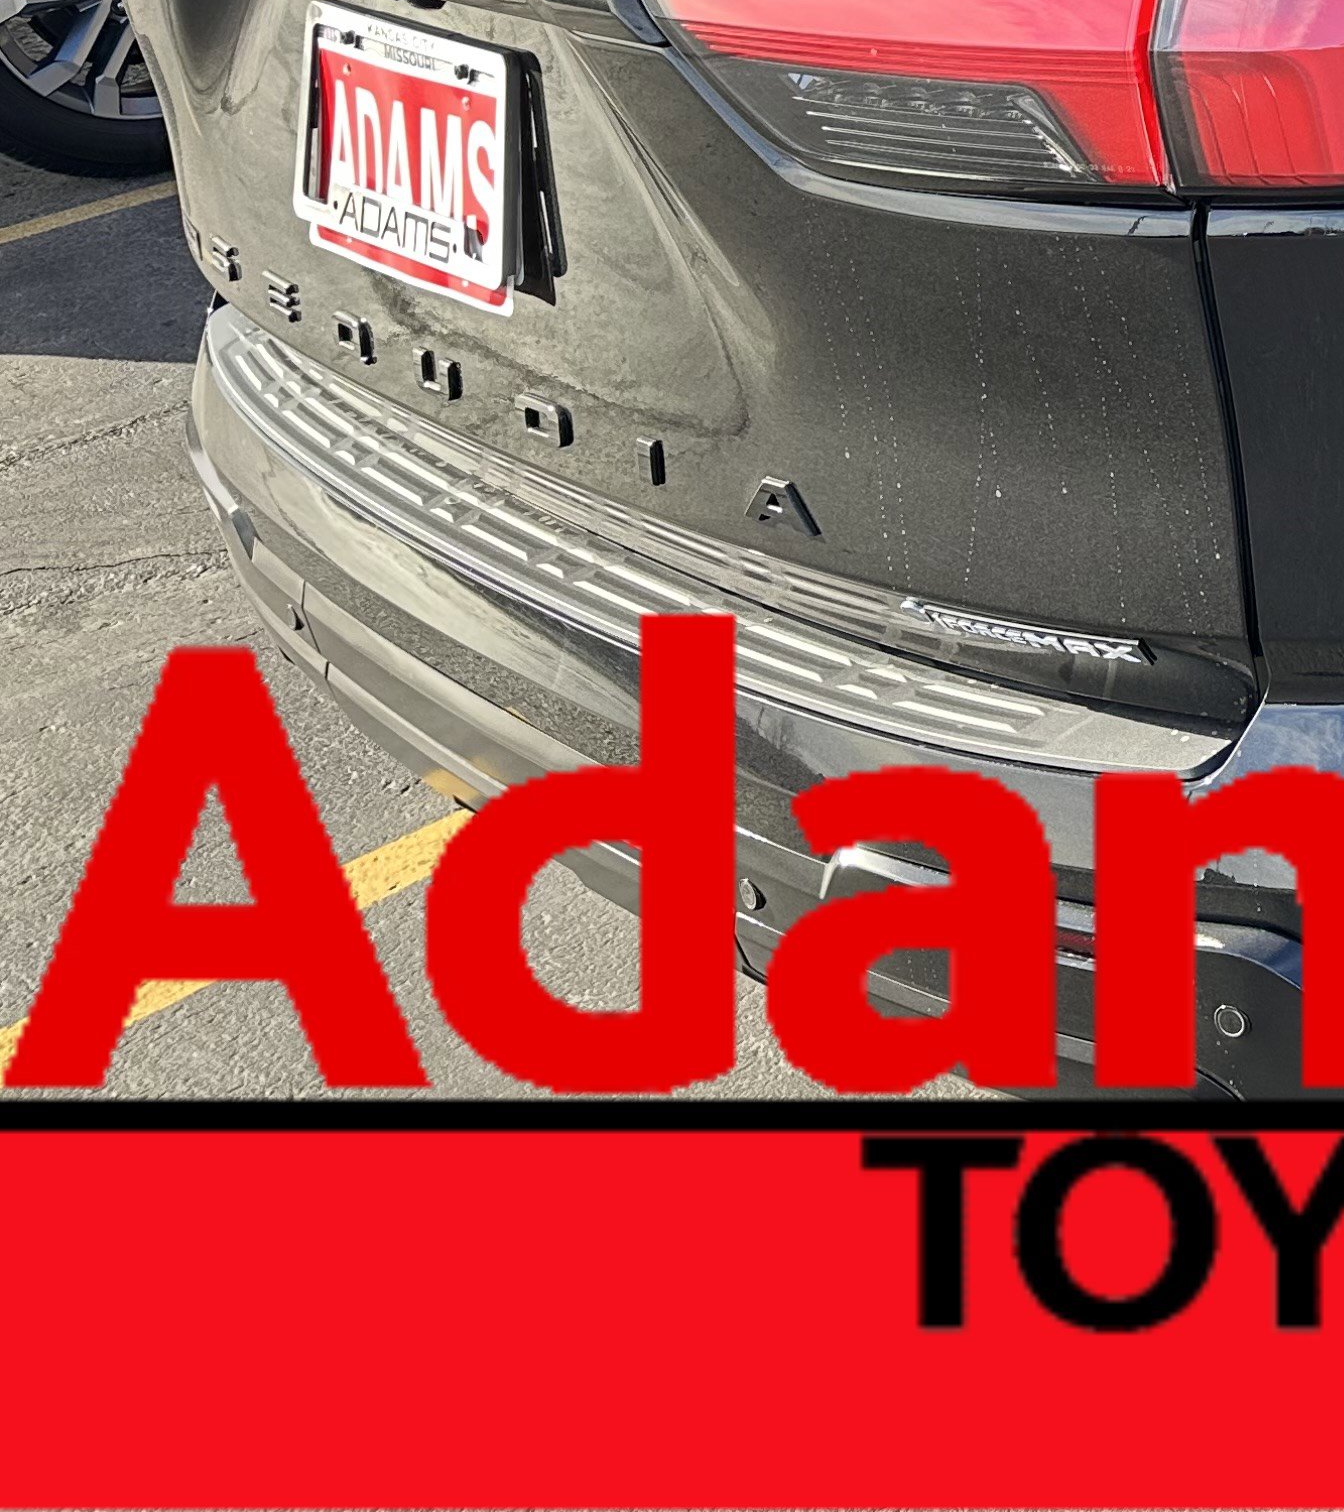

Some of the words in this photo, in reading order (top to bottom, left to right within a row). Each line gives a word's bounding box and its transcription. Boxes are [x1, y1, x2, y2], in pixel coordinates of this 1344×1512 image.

[383, 43, 437, 72] MISSOURI
[327, 78, 497, 248] ADAMS
[338, 191, 453, 265] ADAMS
[210, 233, 822, 537] SEQUOIA
